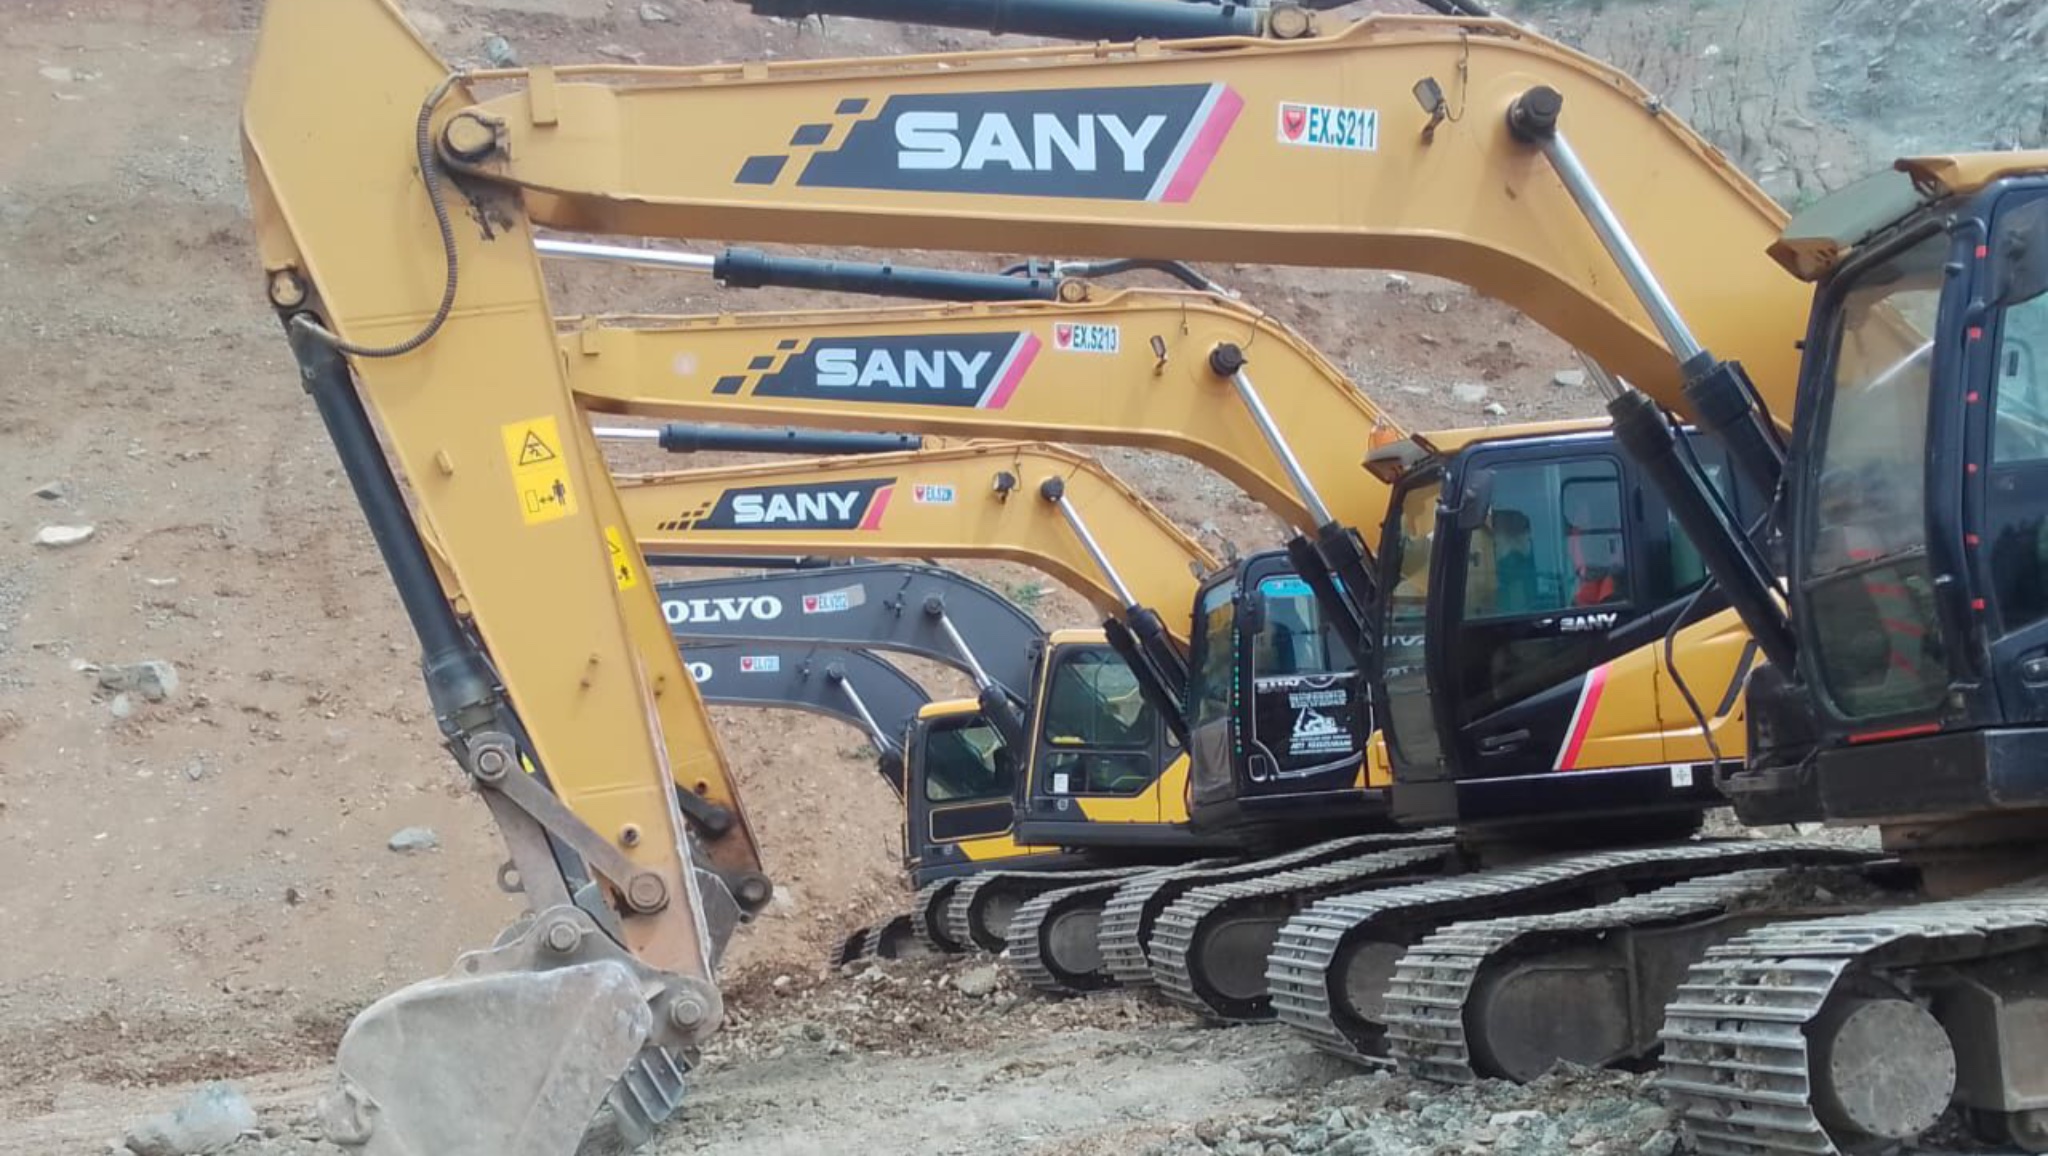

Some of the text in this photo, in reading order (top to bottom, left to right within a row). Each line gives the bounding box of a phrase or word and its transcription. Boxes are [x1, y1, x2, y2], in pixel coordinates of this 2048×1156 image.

[896, 111, 1168, 171] SANY
[1309, 107, 1375, 148] EX.S211
[1073, 325, 1117, 350] EX.S213
[815, 347, 993, 390] SANY
[732, 490, 860, 523] SANY
[661, 595, 783, 624] OLVO
[1560, 612, 1618, 632] SANY
